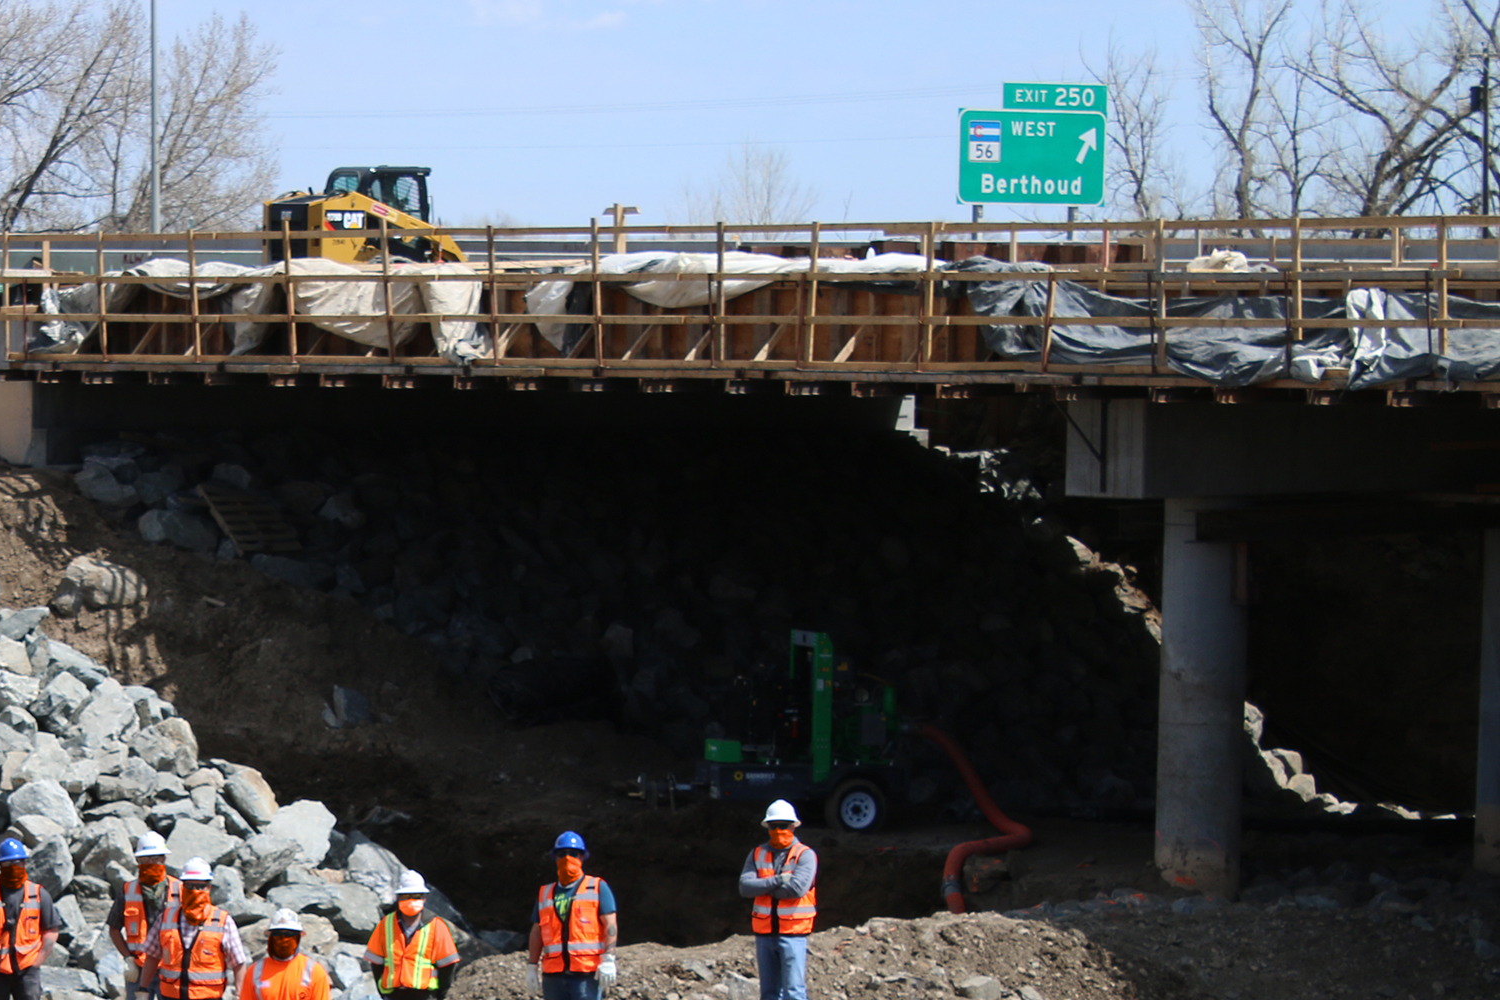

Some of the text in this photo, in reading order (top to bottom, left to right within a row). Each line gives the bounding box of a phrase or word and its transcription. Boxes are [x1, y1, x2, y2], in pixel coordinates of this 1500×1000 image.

[1015, 87, 1096, 107] EXIT 250
[1011, 121, 1056, 137] WEST
[975, 143, 993, 160] 56
[981, 174, 1082, 195] Berthoud
[343, 211, 366, 230] CAT
[123, 253, 145, 265] RLW
